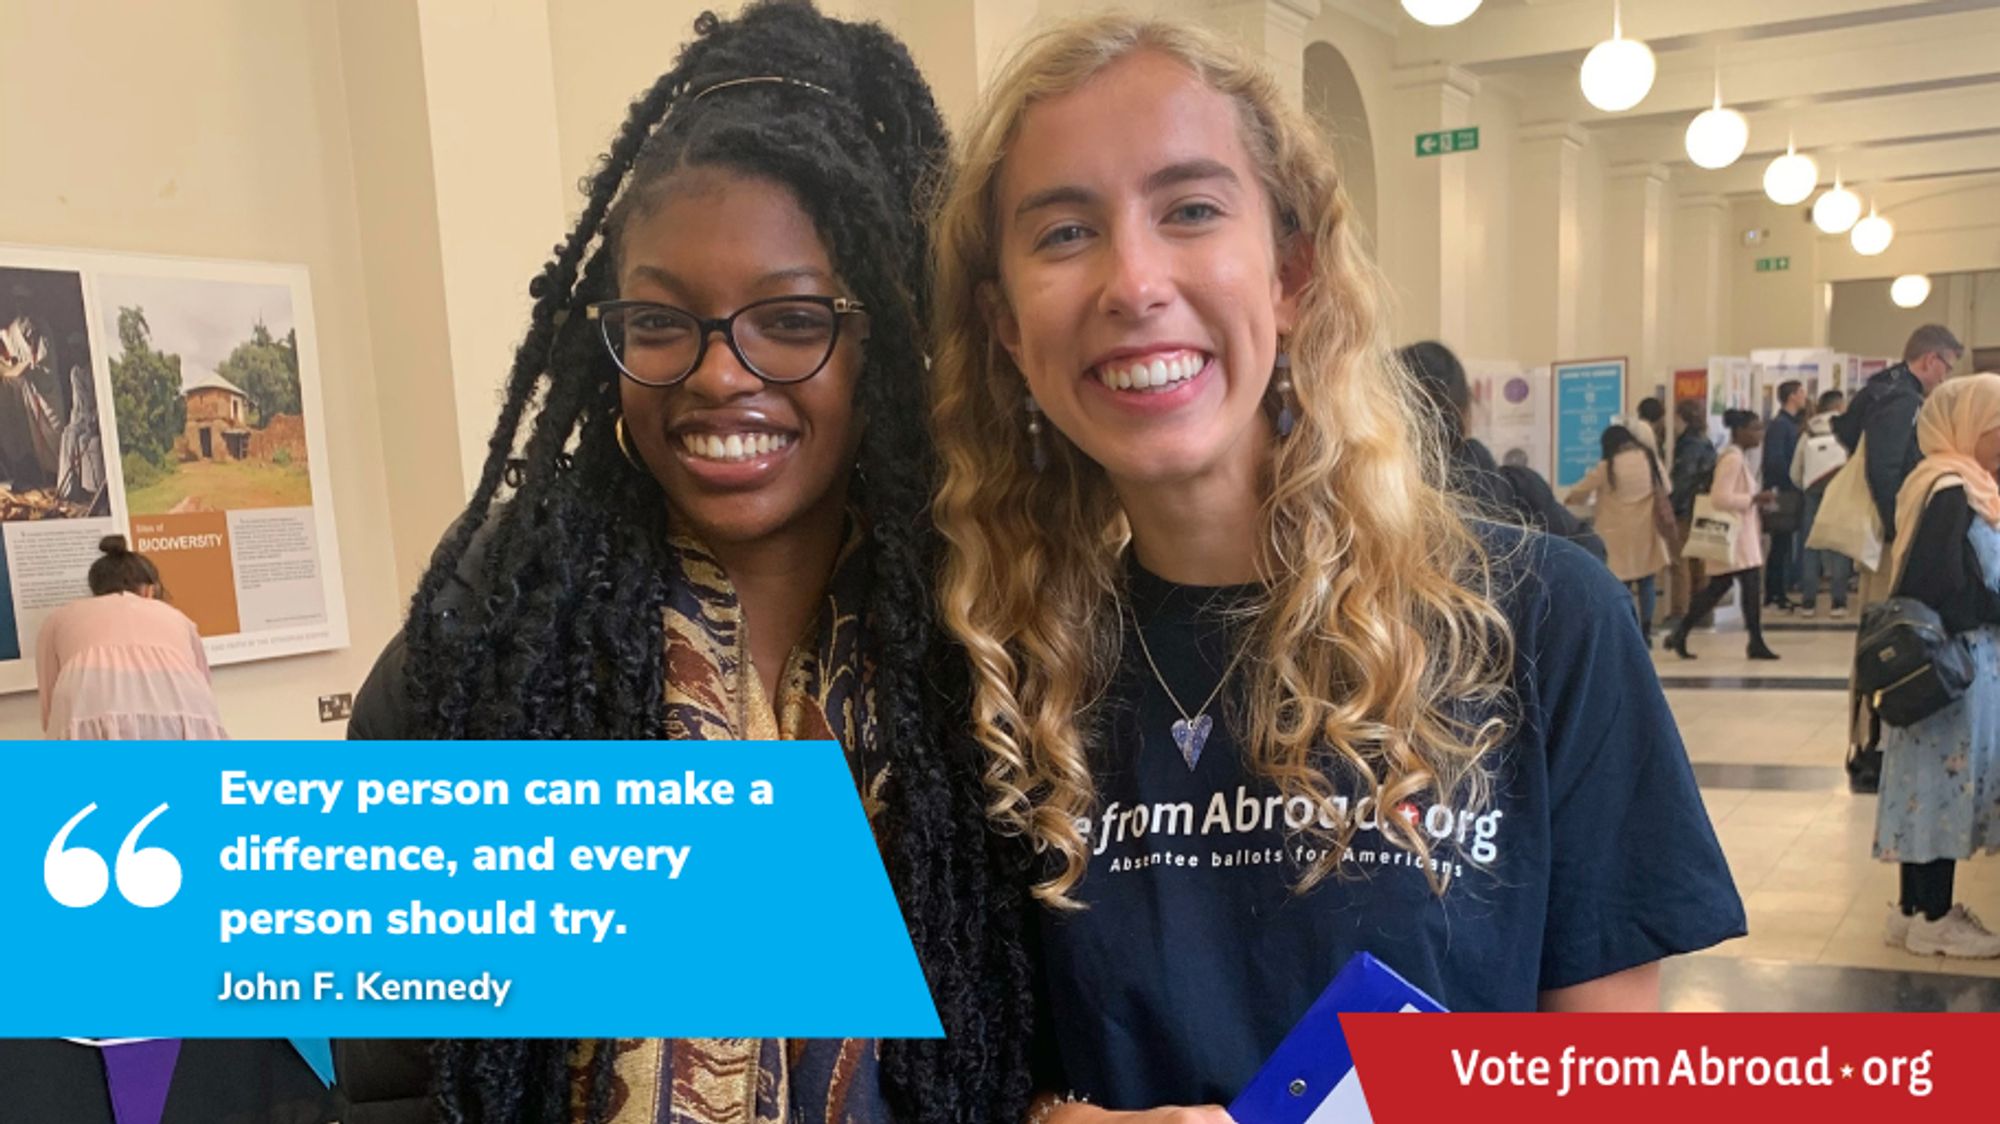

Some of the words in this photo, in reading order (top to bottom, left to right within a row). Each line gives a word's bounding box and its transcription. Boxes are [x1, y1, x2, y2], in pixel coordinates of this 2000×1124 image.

[138, 533, 223, 552] BIODIVERSITY
[1109, 850, 1199, 872] Absentee
[1211, 848, 1283, 867] ballots
[1295, 846, 1327, 862] for
